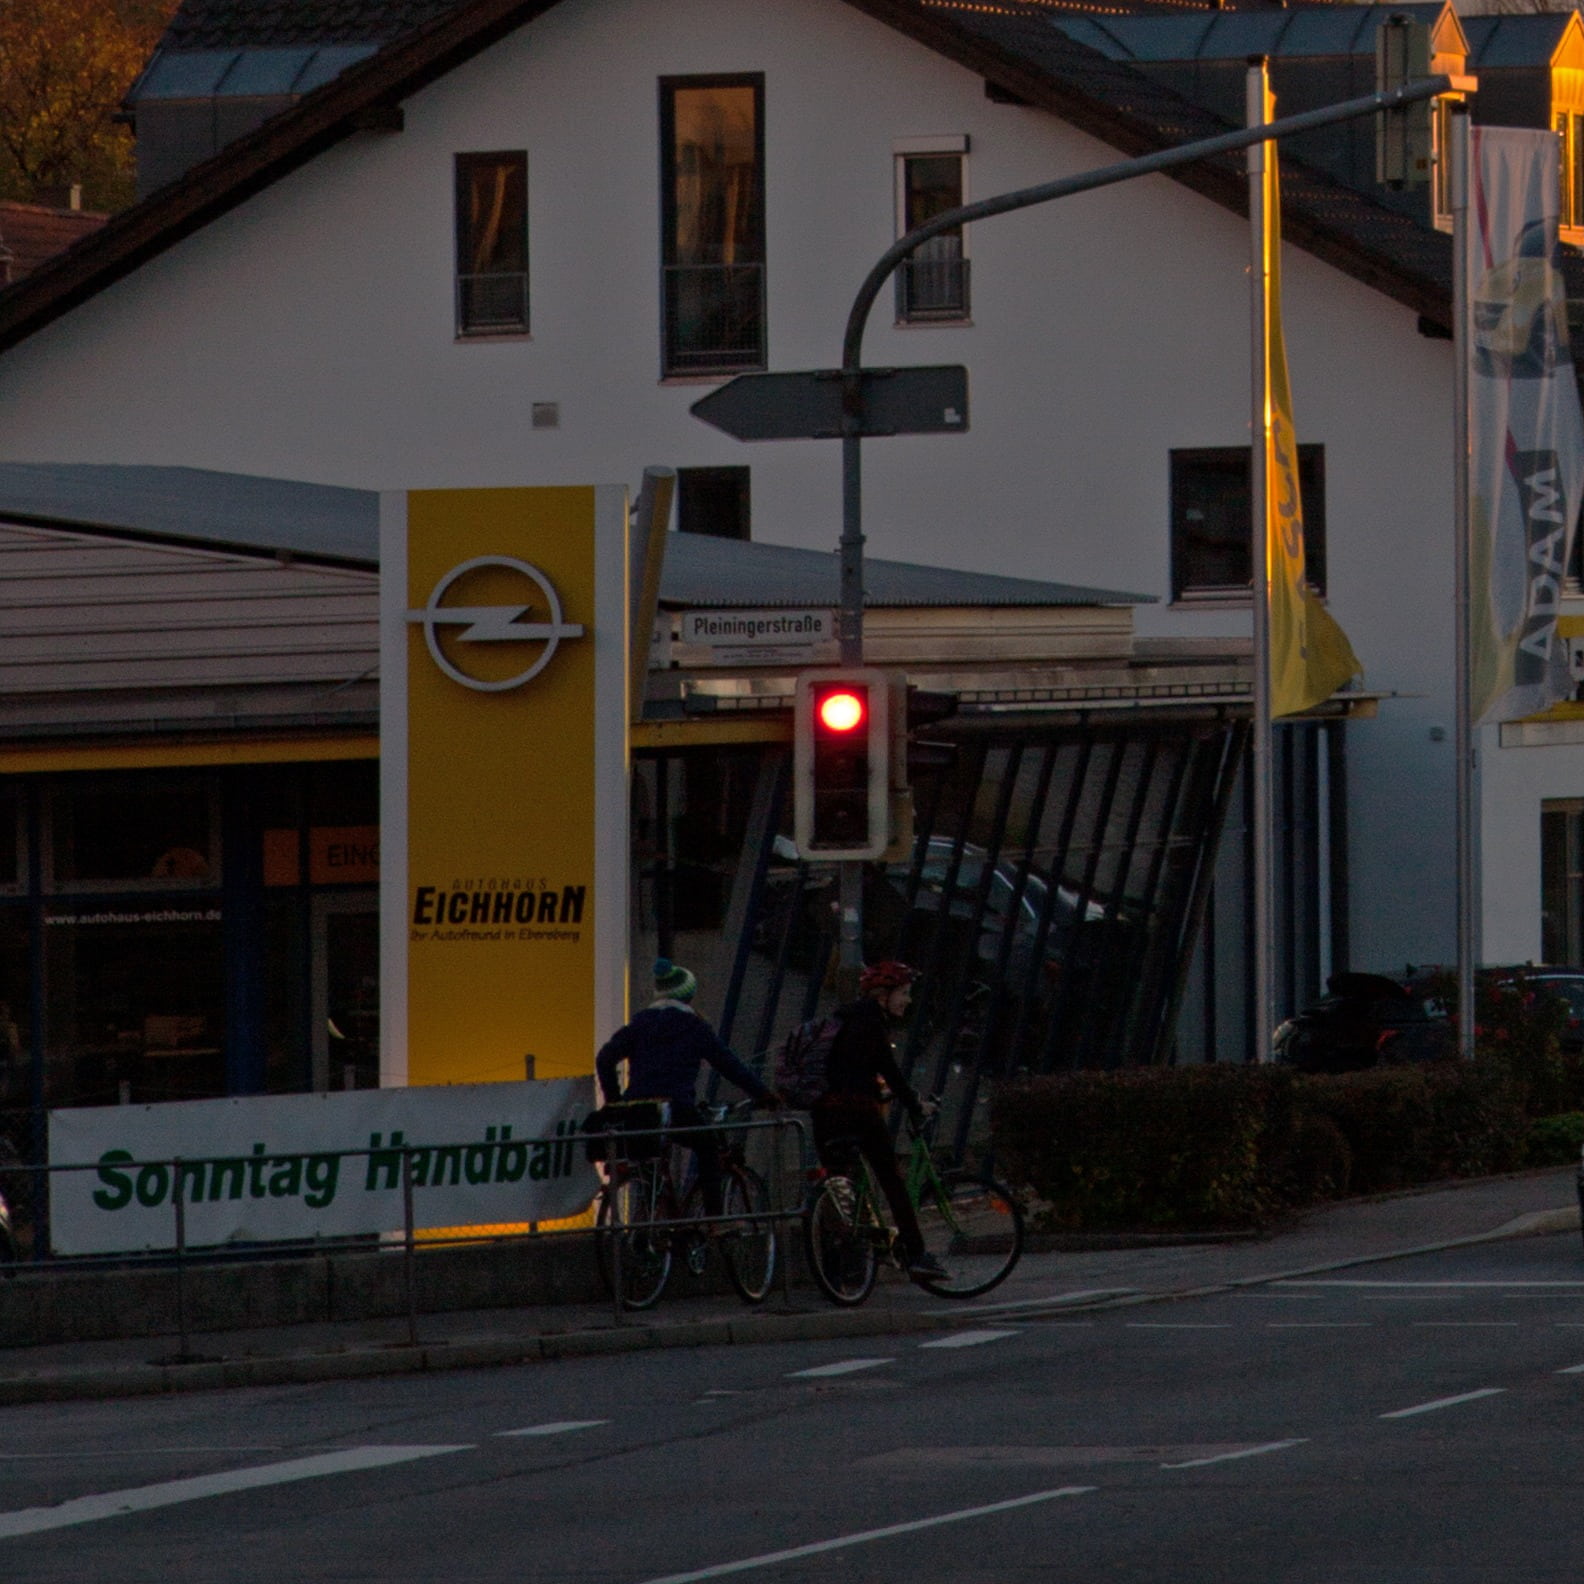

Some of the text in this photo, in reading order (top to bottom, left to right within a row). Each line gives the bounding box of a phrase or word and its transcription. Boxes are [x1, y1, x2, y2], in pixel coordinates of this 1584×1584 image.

[1519, 466, 1566, 661] ADAM
[694, 616, 822, 638] Pleiningerstraße
[414, 886, 586, 924] EICHHORN
[431, 929, 500, 941] Autofreund
[93, 1125, 575, 1210] Sonntag Handball
